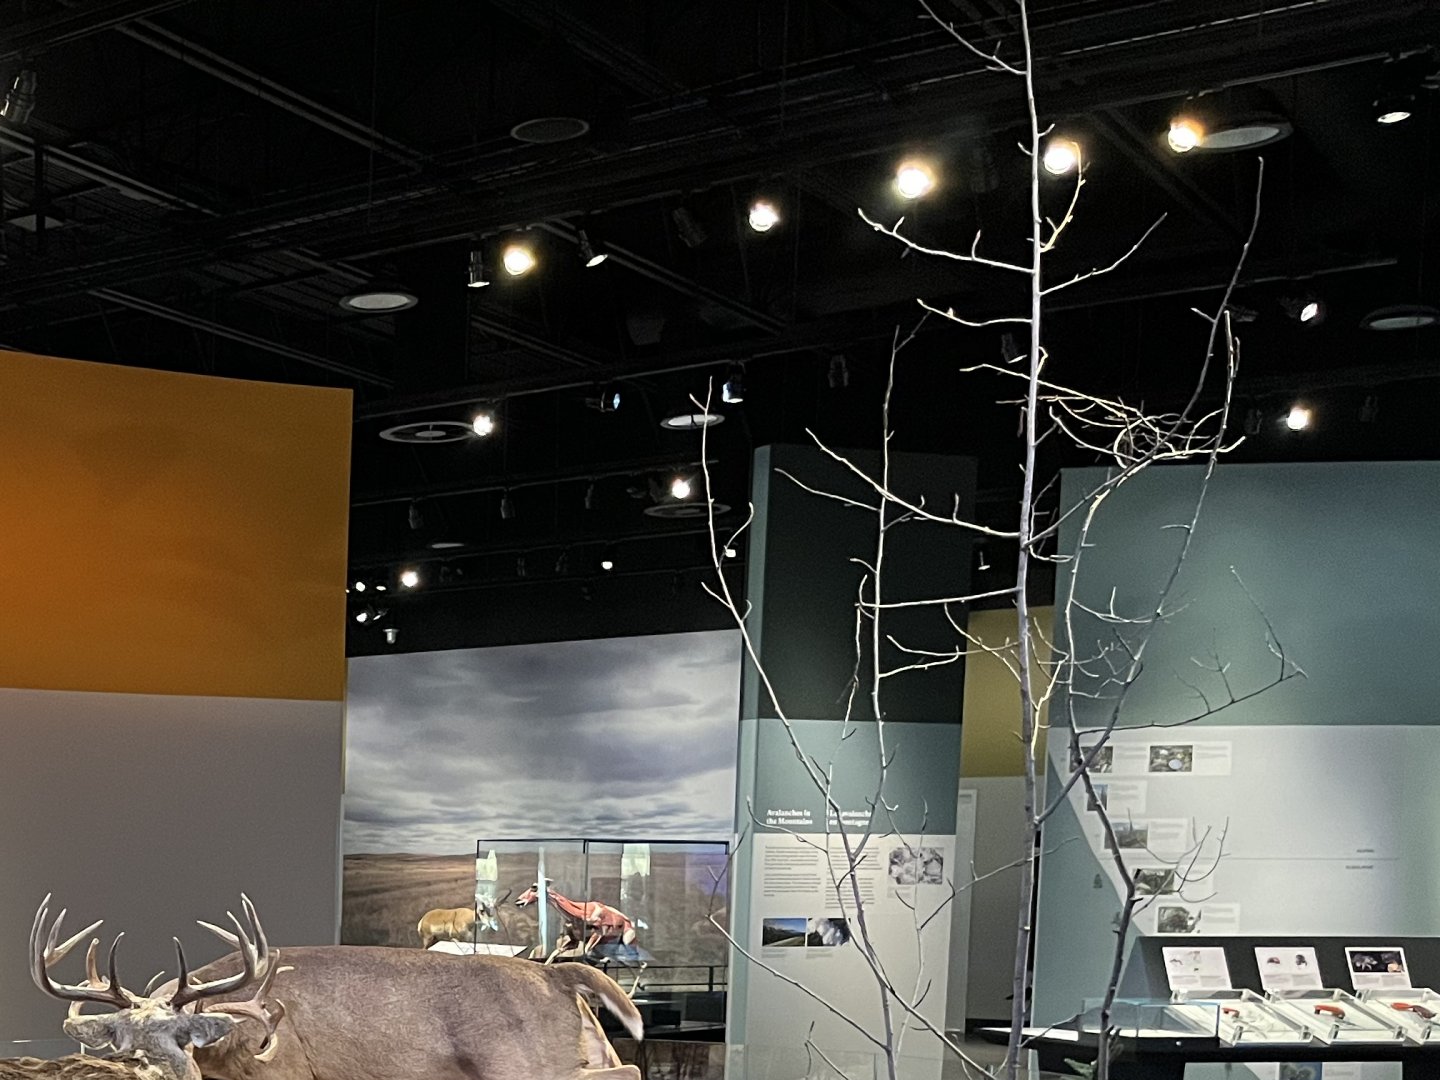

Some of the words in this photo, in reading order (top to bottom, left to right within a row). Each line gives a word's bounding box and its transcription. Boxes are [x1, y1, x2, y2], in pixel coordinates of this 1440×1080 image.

[767, 809, 803, 817] Avalanches
[803, 809, 811, 817] in
[766, 817, 777, 825] the
[777, 817, 813, 825] Mountains
